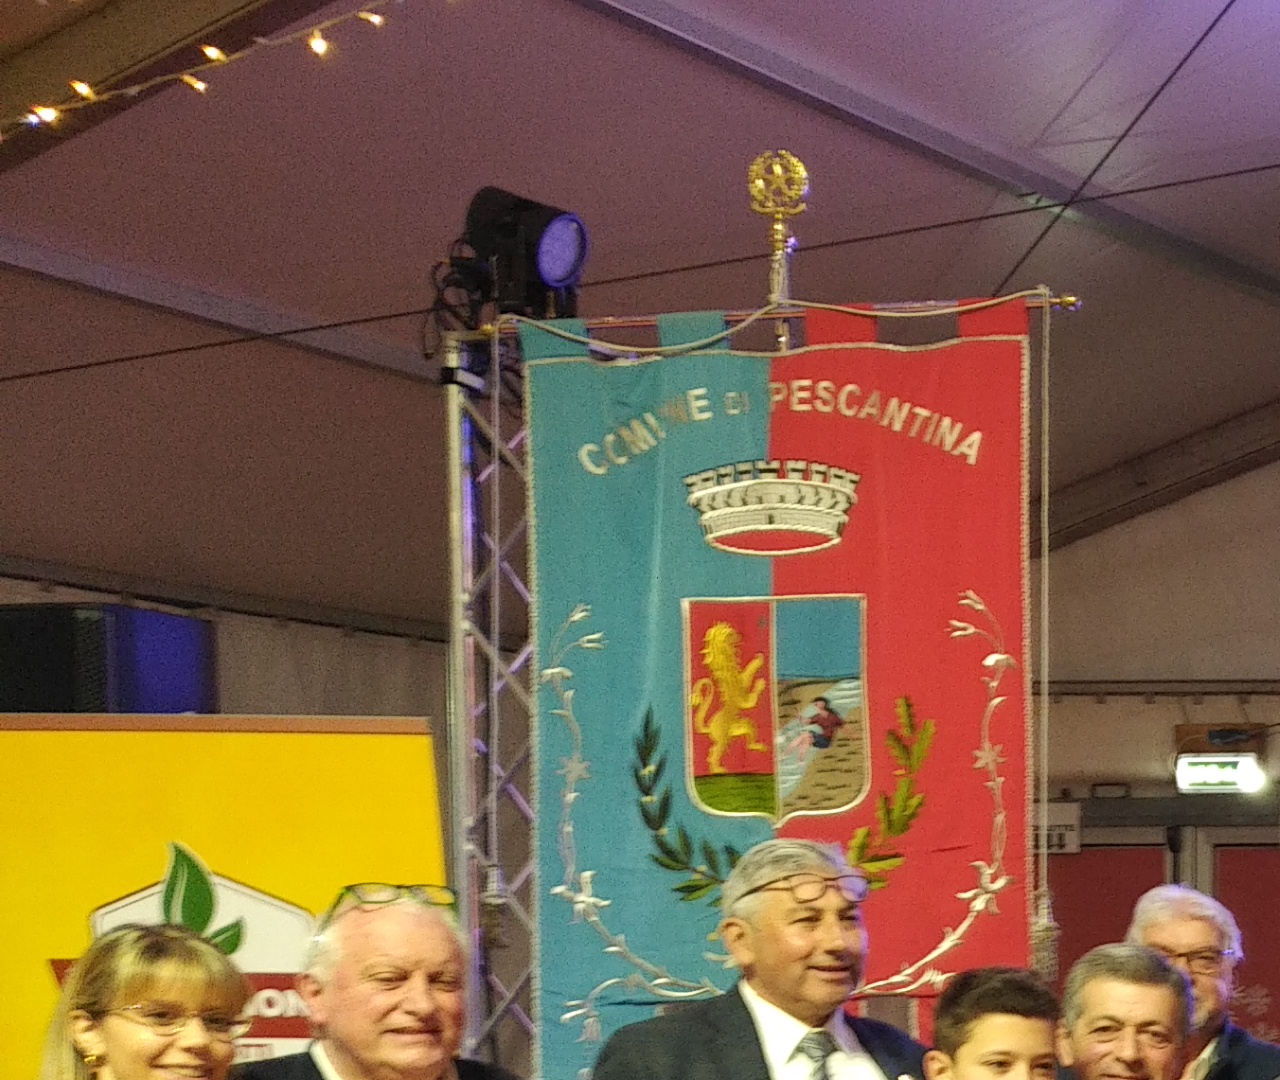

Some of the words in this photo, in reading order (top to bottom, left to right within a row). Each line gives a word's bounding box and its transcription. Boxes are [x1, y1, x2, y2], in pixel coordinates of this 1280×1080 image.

[577, 387, 714, 476] COMUNE
[724, 391, 750, 415] DI
[768, 379, 984, 465] PESCANTINA
